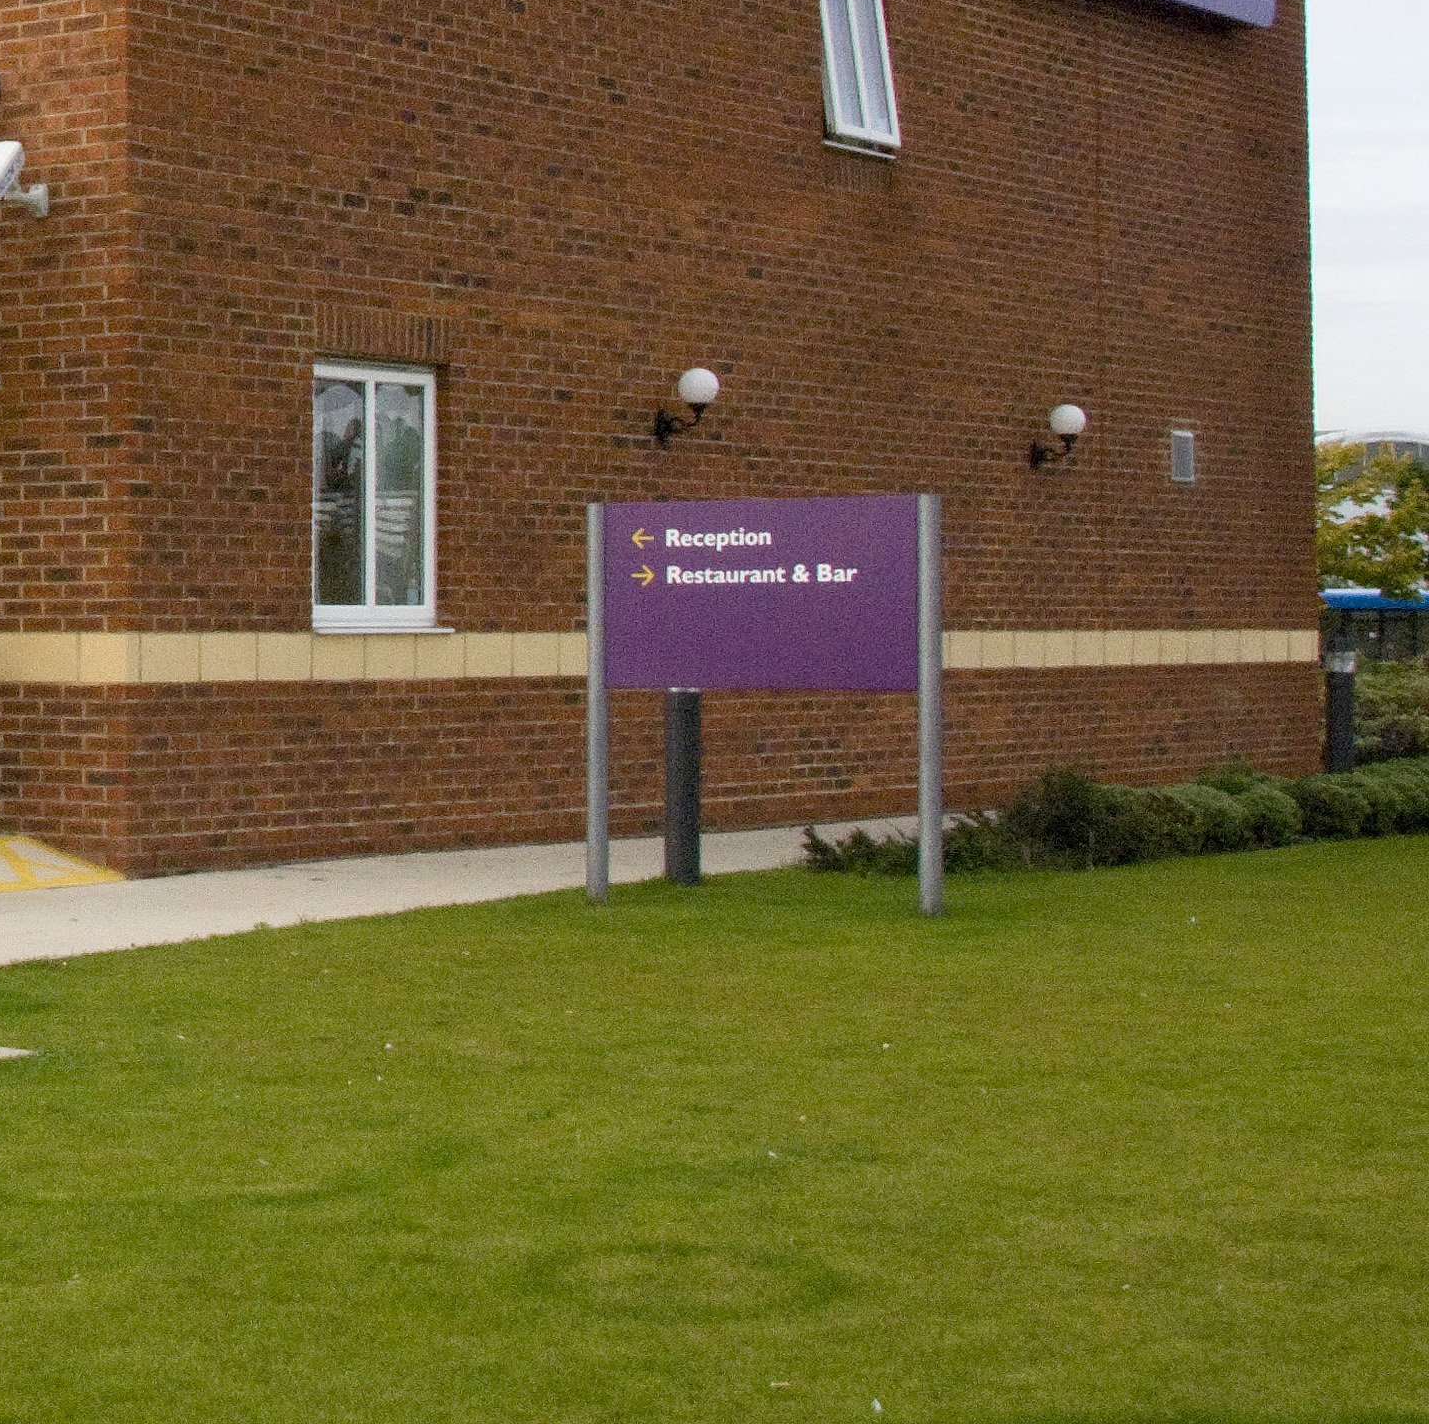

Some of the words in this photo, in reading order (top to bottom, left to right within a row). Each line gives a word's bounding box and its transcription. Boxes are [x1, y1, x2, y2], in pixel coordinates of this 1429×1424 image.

[664, 527, 773, 552] Reception
[665, 564, 786, 585] Restaurant
[791, 563, 811, 584] &
[815, 562, 858, 584] Bar
